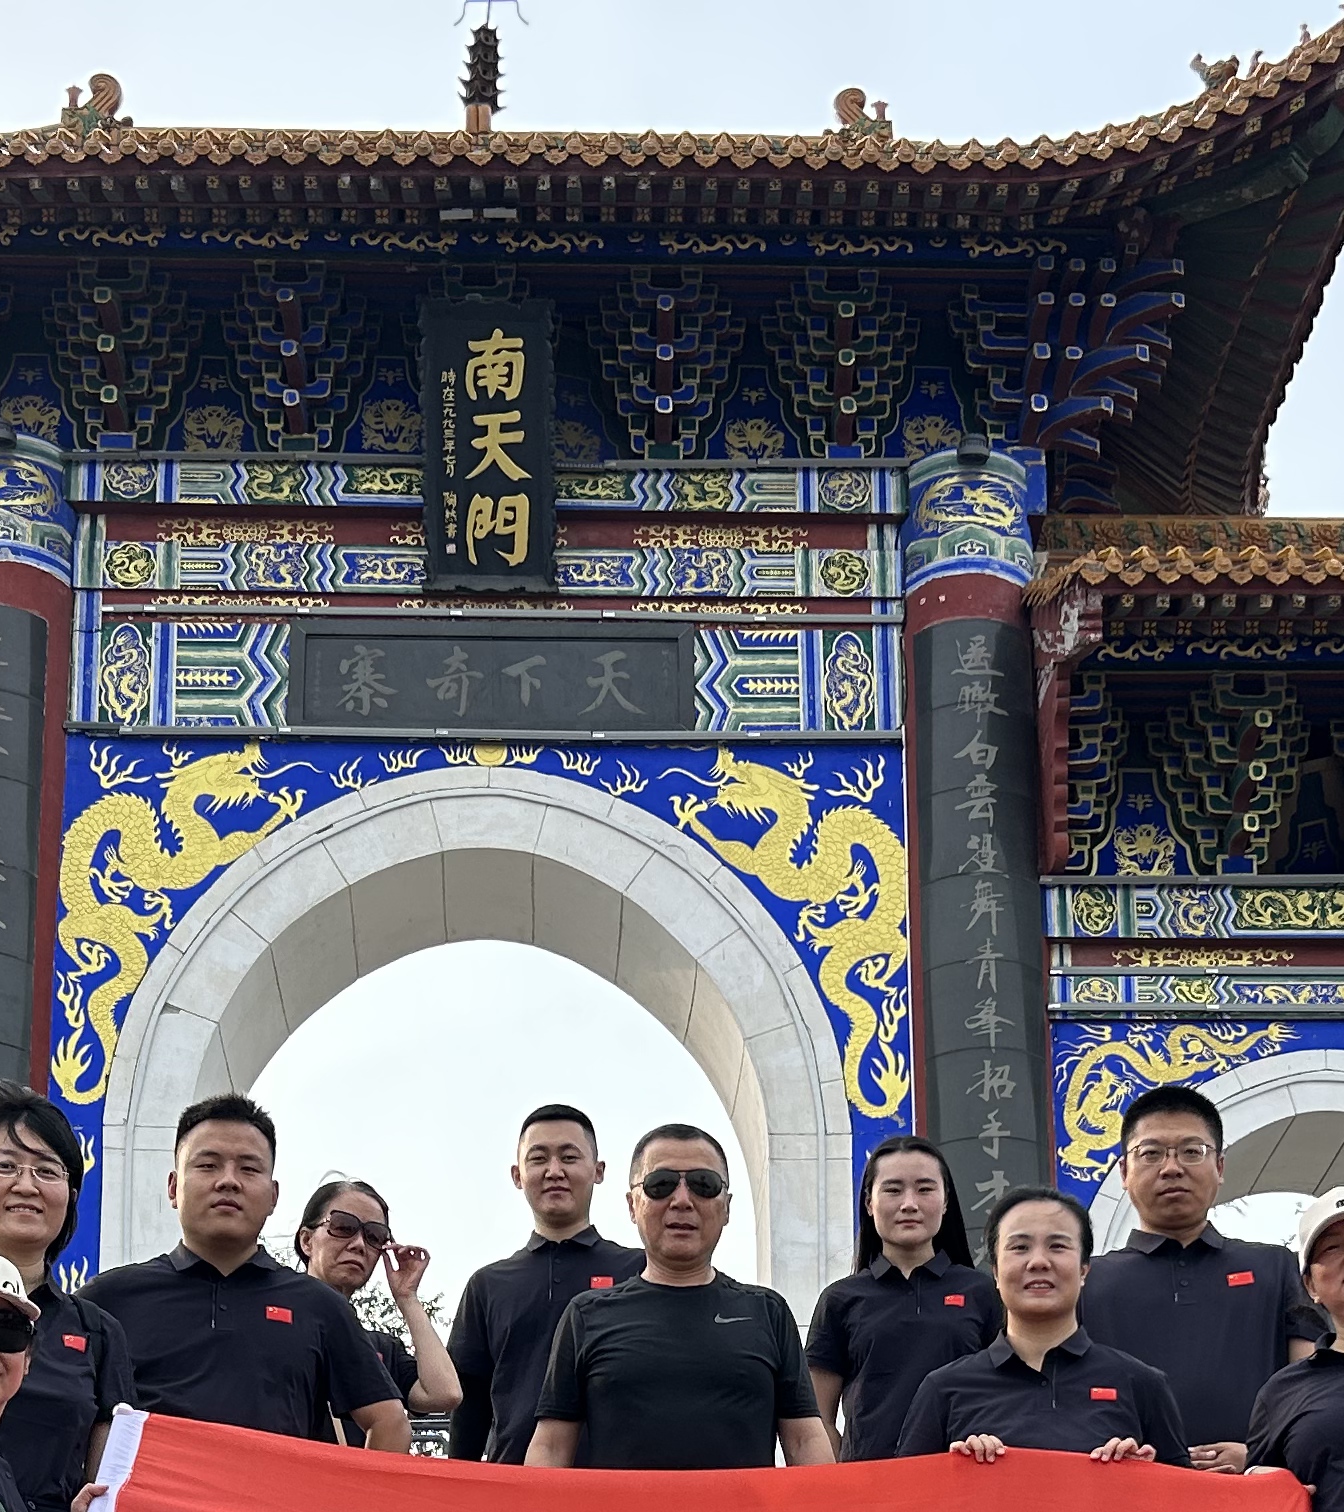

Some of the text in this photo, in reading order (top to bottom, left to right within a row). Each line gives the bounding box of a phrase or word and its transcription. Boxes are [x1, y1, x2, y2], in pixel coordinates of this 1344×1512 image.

[464, 328, 532, 566] 南天門
[336, 644, 646, 717] 天下奇寨
